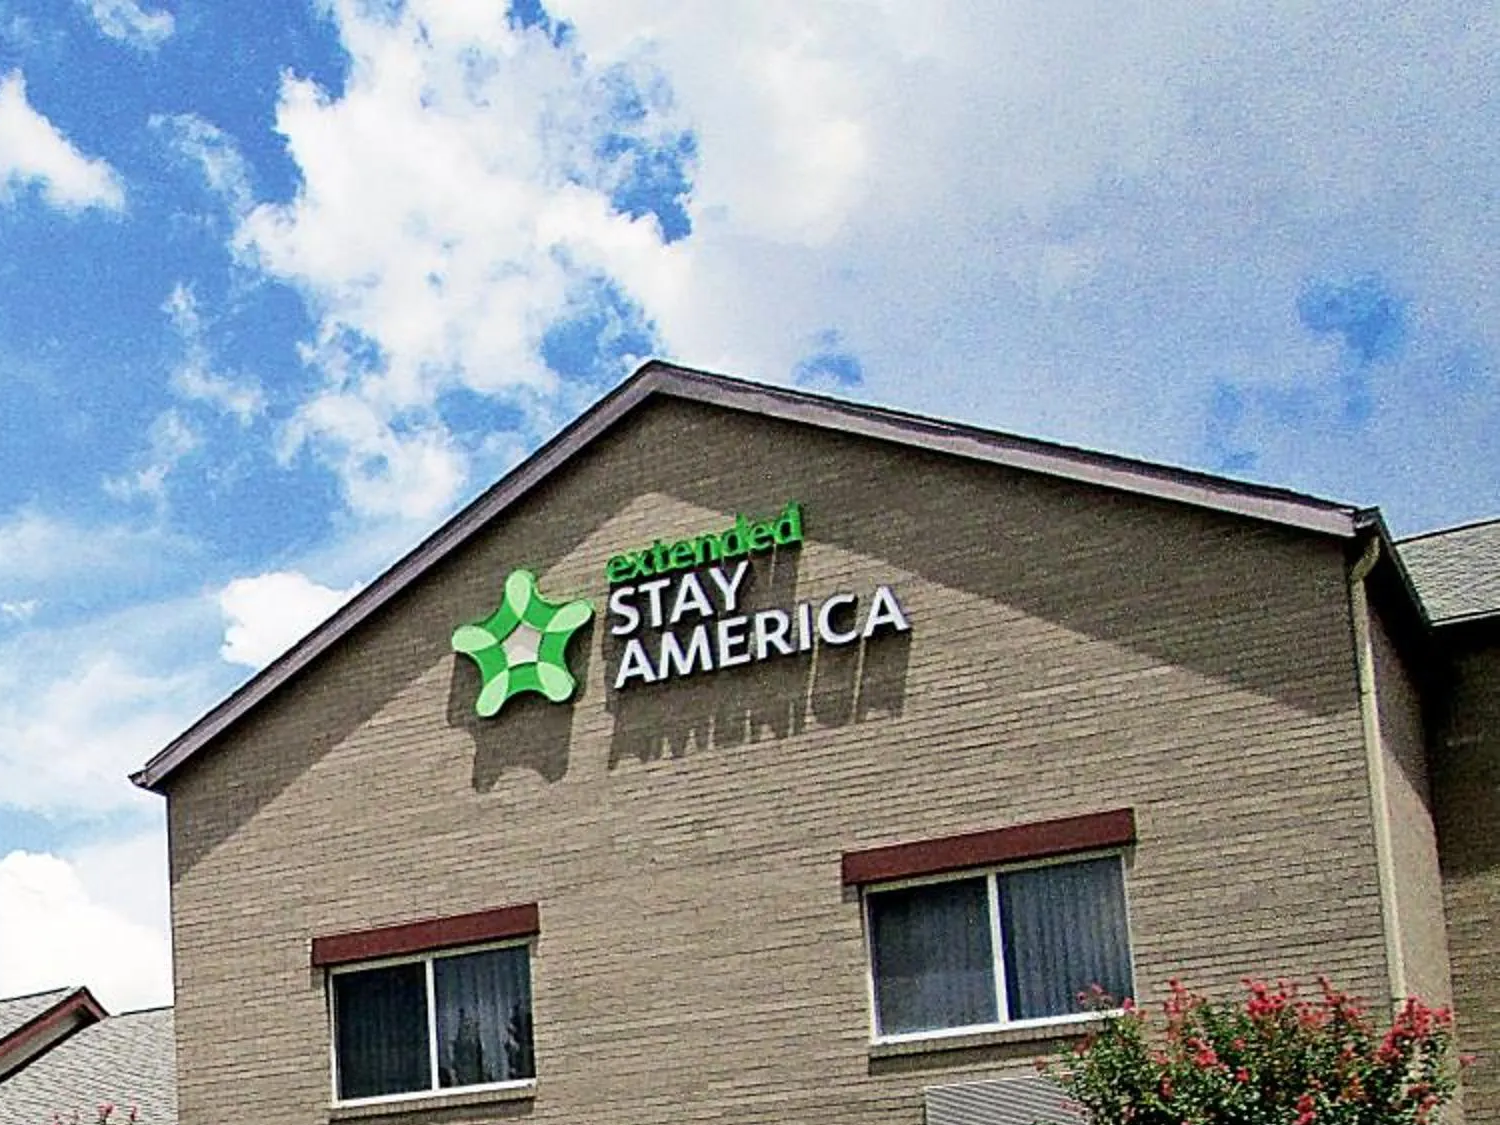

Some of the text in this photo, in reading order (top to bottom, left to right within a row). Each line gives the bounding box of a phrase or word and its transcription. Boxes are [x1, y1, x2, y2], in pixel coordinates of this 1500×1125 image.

[606, 500, 804, 583] extended
[610, 559, 750, 636] STAY
[613, 586, 909, 690] AMERICA
